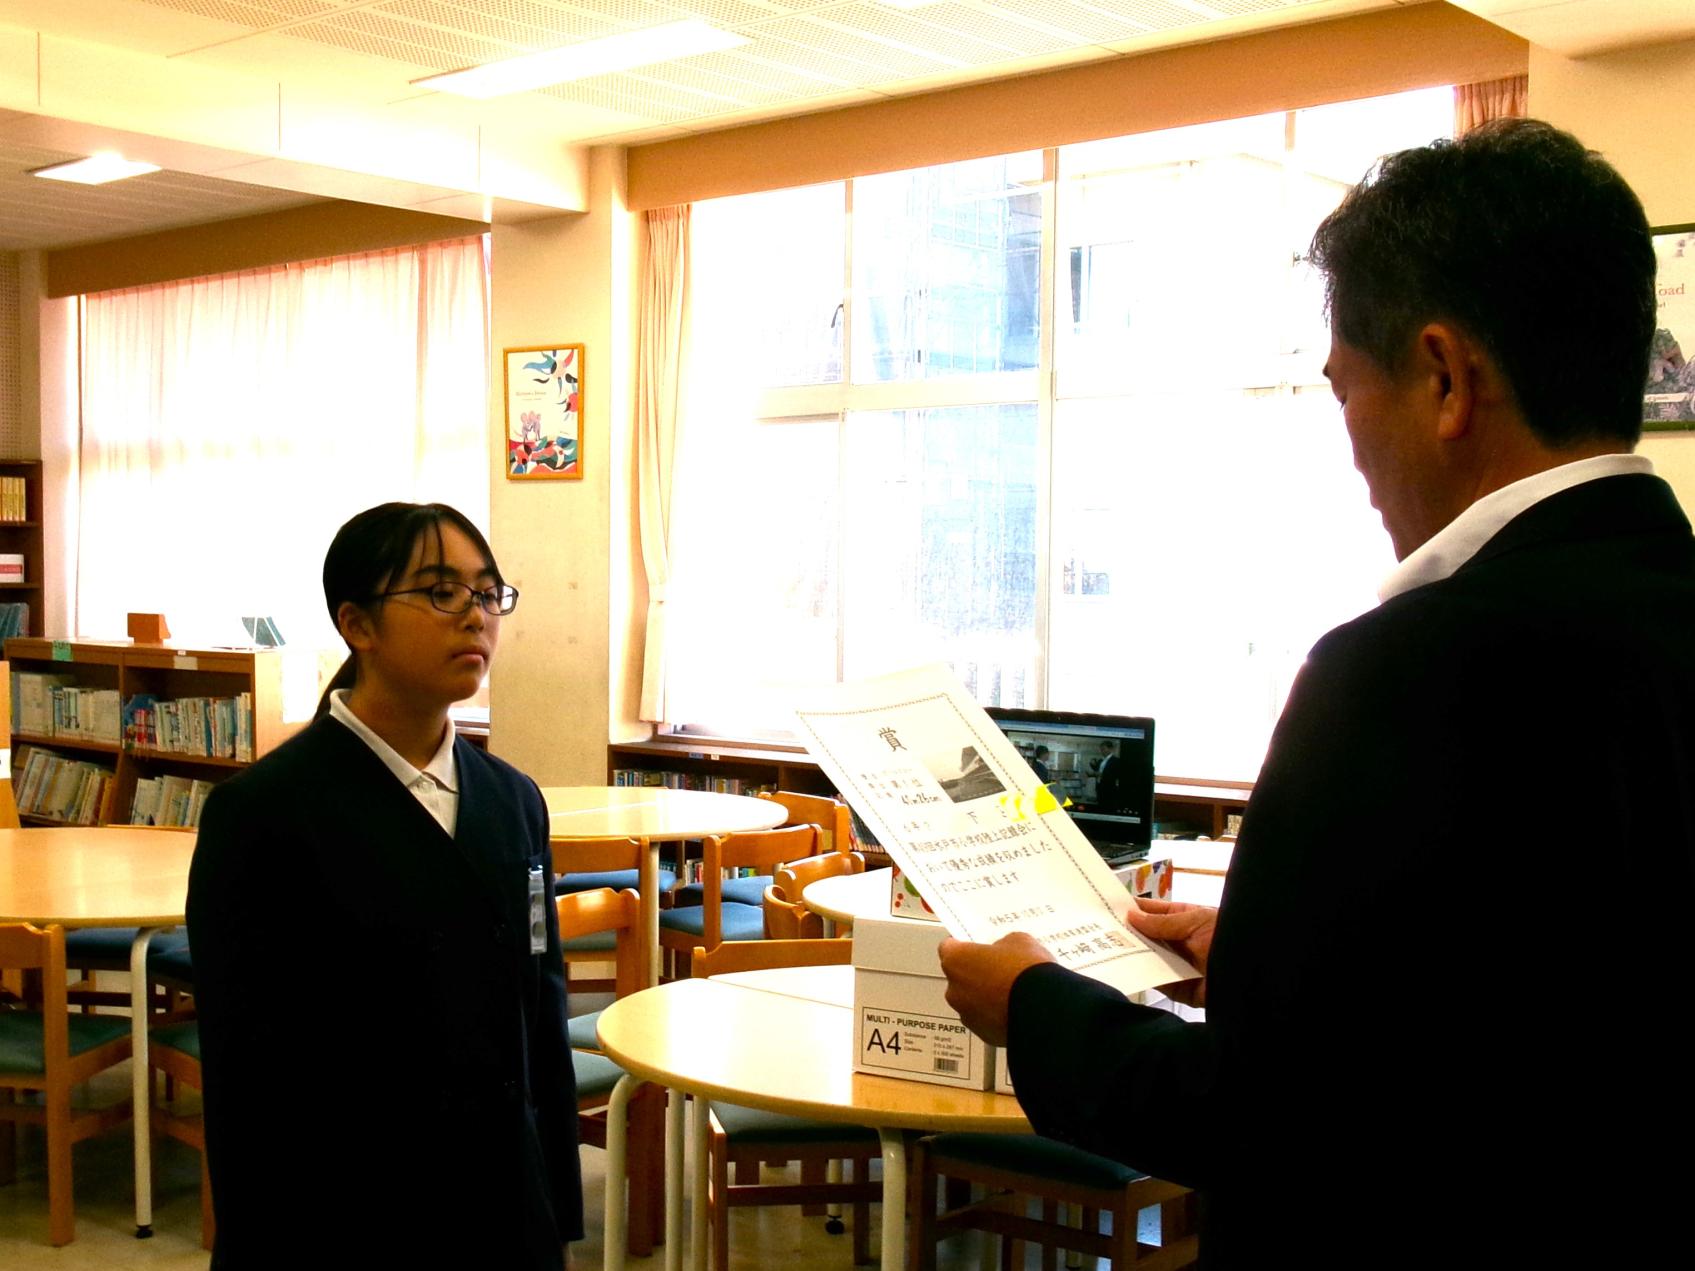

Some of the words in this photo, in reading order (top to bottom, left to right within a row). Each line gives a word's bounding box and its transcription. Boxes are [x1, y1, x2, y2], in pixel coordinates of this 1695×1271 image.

[879, 727, 907, 752] 賞
[867, 1014, 890, 1025] MULTI
[897, 1018, 936, 1031] PURPOSE
[938, 1024, 966, 1034] PAPER
[867, 1028, 901, 1055] A4
